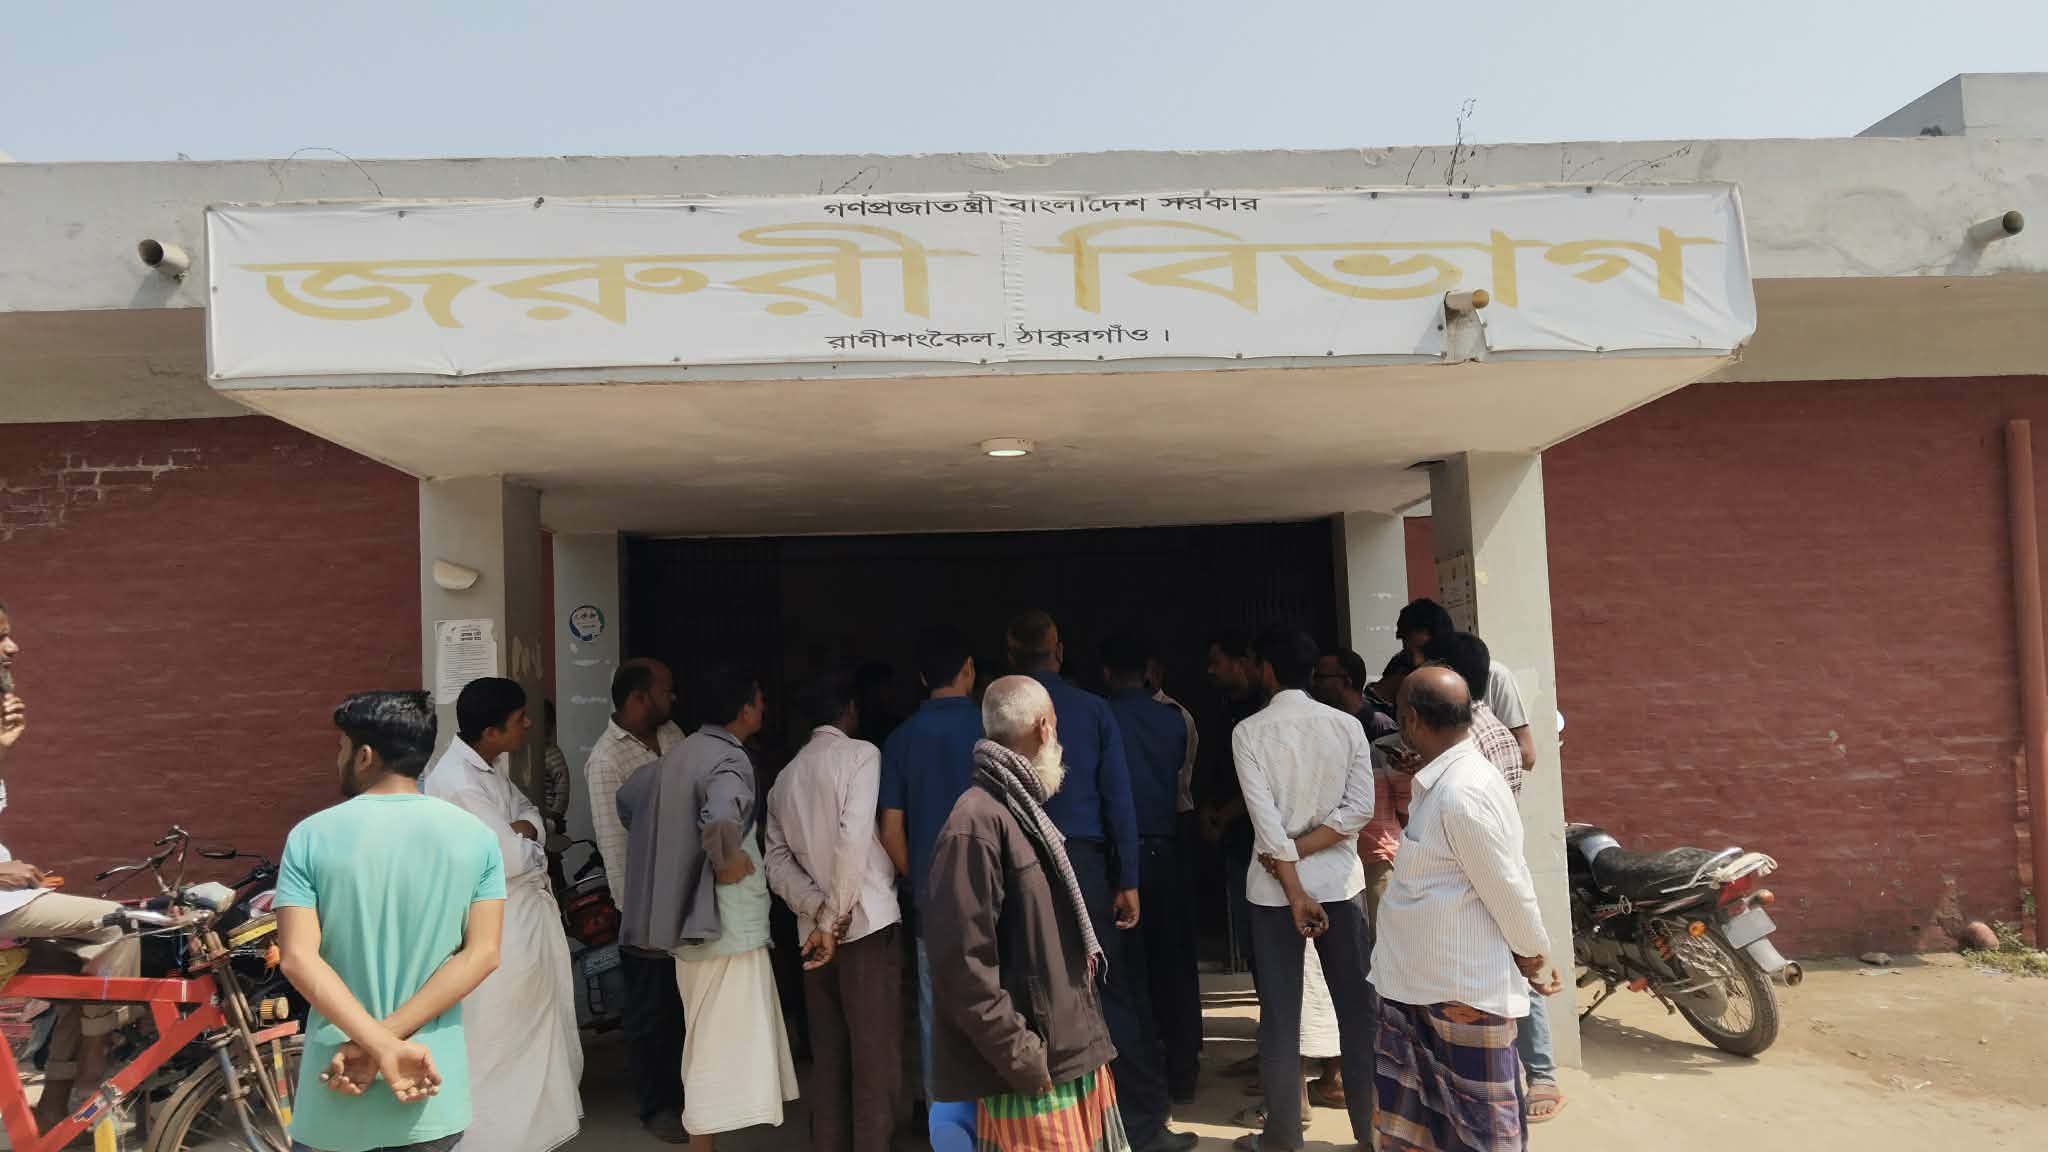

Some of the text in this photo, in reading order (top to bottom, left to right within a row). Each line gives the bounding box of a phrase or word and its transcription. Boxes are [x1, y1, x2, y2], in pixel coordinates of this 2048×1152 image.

[824, 192, 1258, 217] গণপ্রজাতন্ত্রী বাংলাদেশ সরকার
[239, 218, 1726, 328] জরুরী বিভাগ
[1015, 323, 1149, 348] ঠাকুরগাঁও
